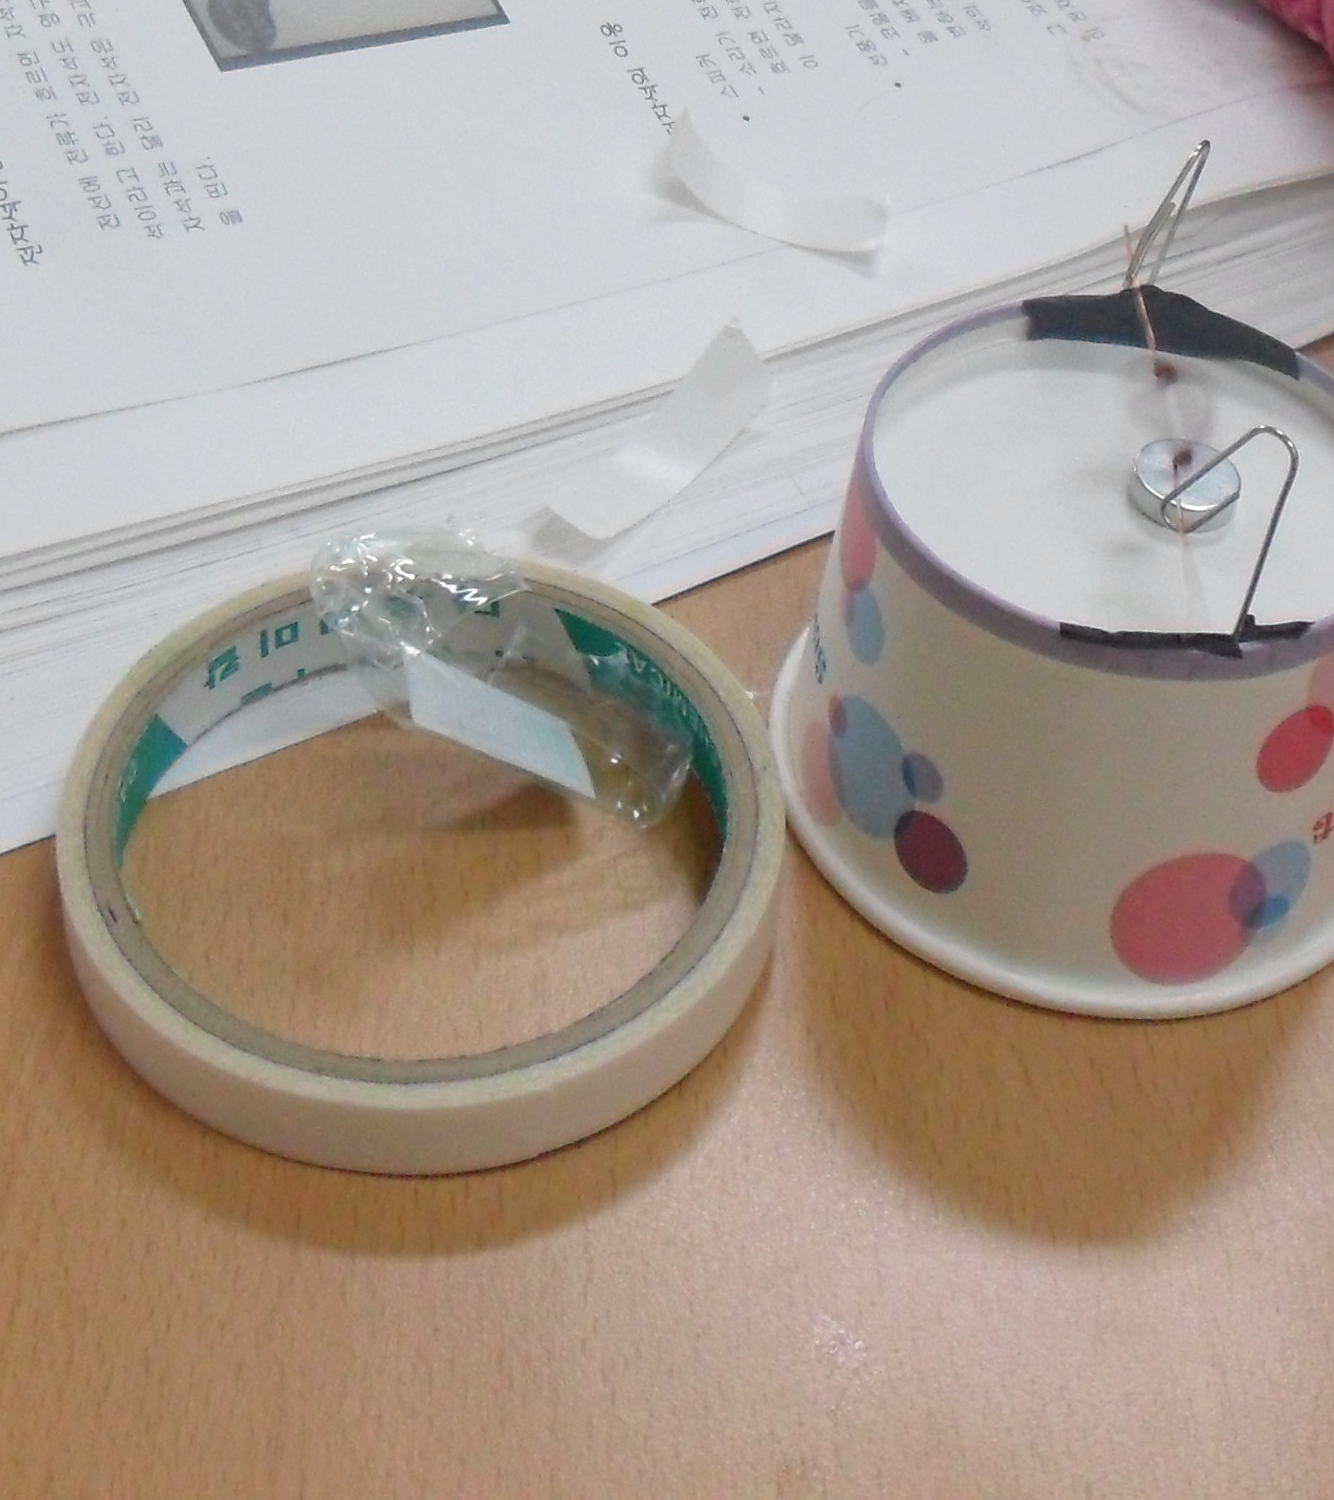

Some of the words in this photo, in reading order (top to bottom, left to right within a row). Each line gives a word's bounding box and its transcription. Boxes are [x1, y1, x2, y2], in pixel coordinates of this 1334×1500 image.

[598, 21, 629, 58] 이용
[713, 29, 758, 76] 소리가
[15, 50, 58, 102] 흐르면
[49, 37, 101, 107] 전자석도
[88, 37, 141, 107] 전자석은
[693, 52, 740, 98] 스피커
[44, 111, 89, 166] 전류가
[128, 115, 164, 151] 달리
[76, 174, 122, 231] 전선에
[114, 165, 164, 240] 석이라고
[156, 160, 206, 233] 자석과는
